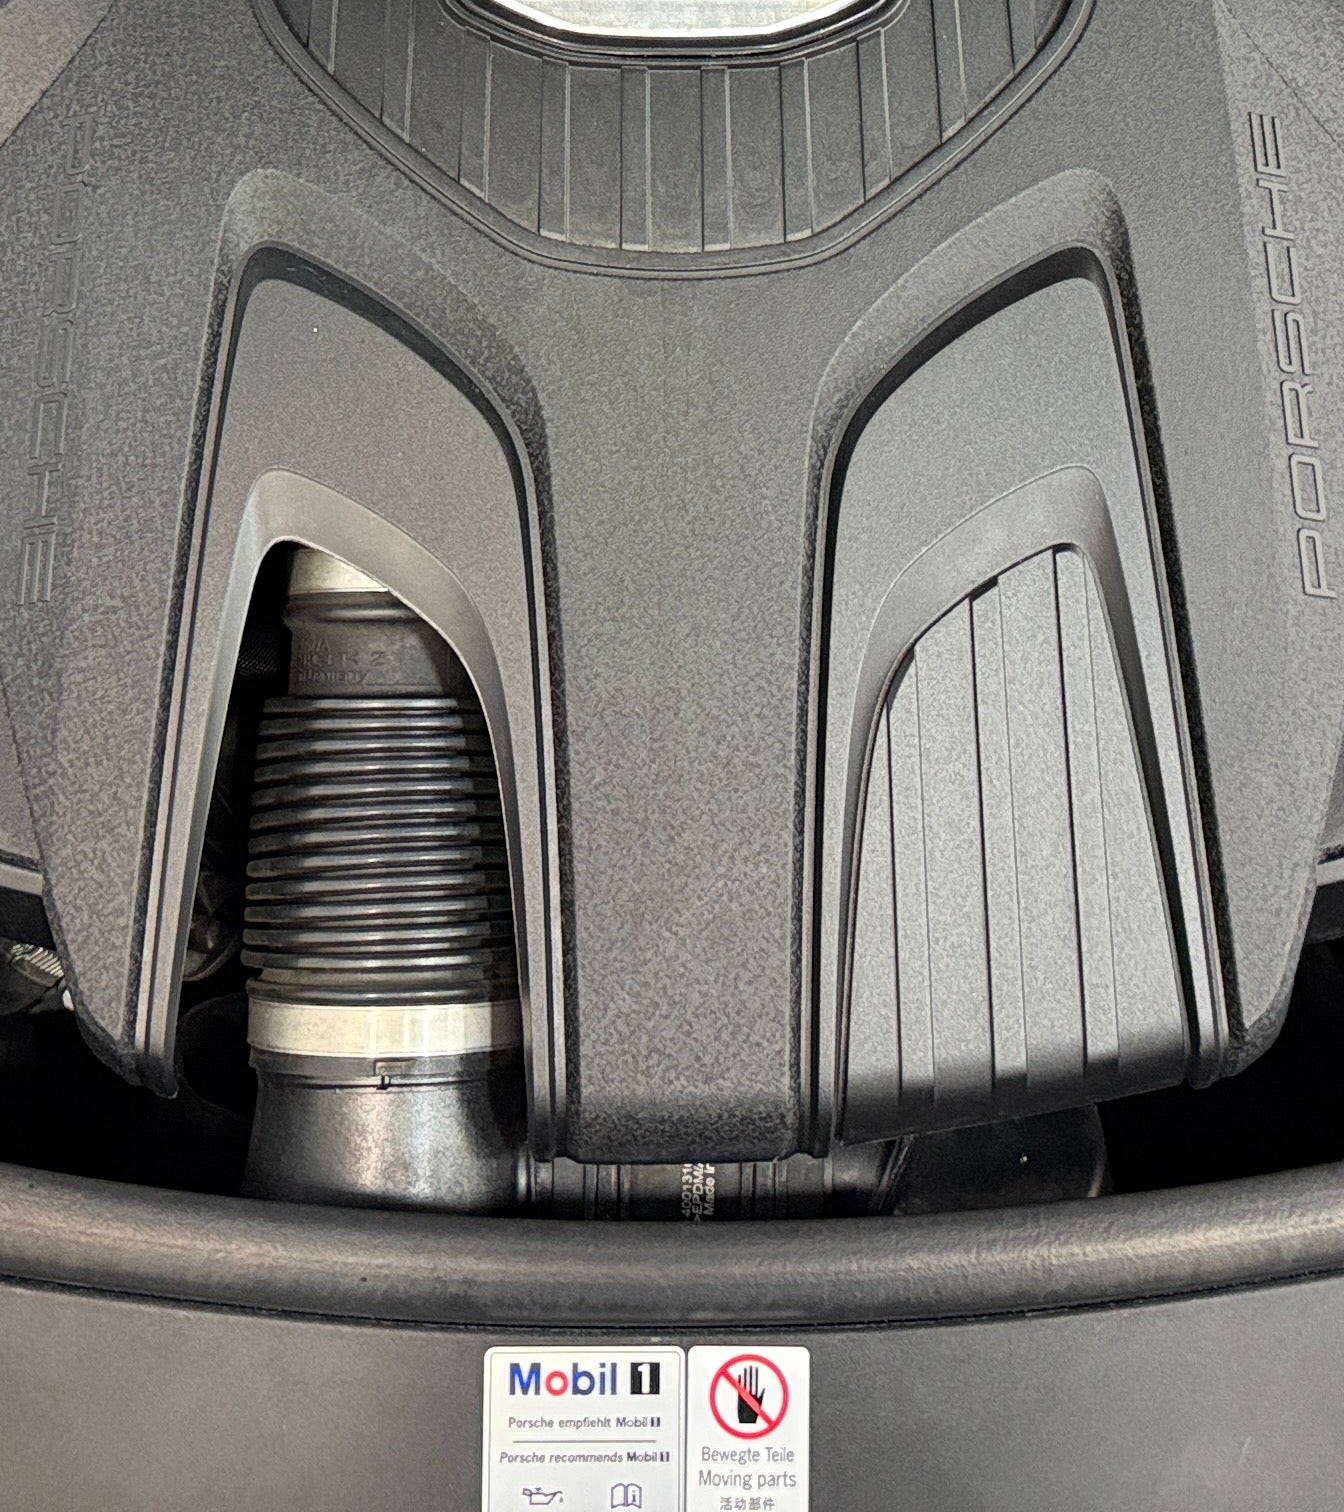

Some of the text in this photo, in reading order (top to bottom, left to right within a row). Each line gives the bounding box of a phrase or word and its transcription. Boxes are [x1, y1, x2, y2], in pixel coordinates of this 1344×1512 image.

[1247, 110, 1338, 600] PORSCHE
[509, 1362, 618, 1396] Mobil
[508, 1416, 554, 1429] Porsche
[558, 1416, 612, 1430] empfiehlt
[615, 1416, 648, 1428] Mobil
[499, 1451, 546, 1463] Porsche
[549, 1451, 624, 1463] recommends
[626, 1451, 657, 1463] Mobil
[701, 1446, 795, 1465] Bewegte Teile
[698, 1469, 797, 1490] Moving parts
[719, 1496, 776, 1511] 活动部件
